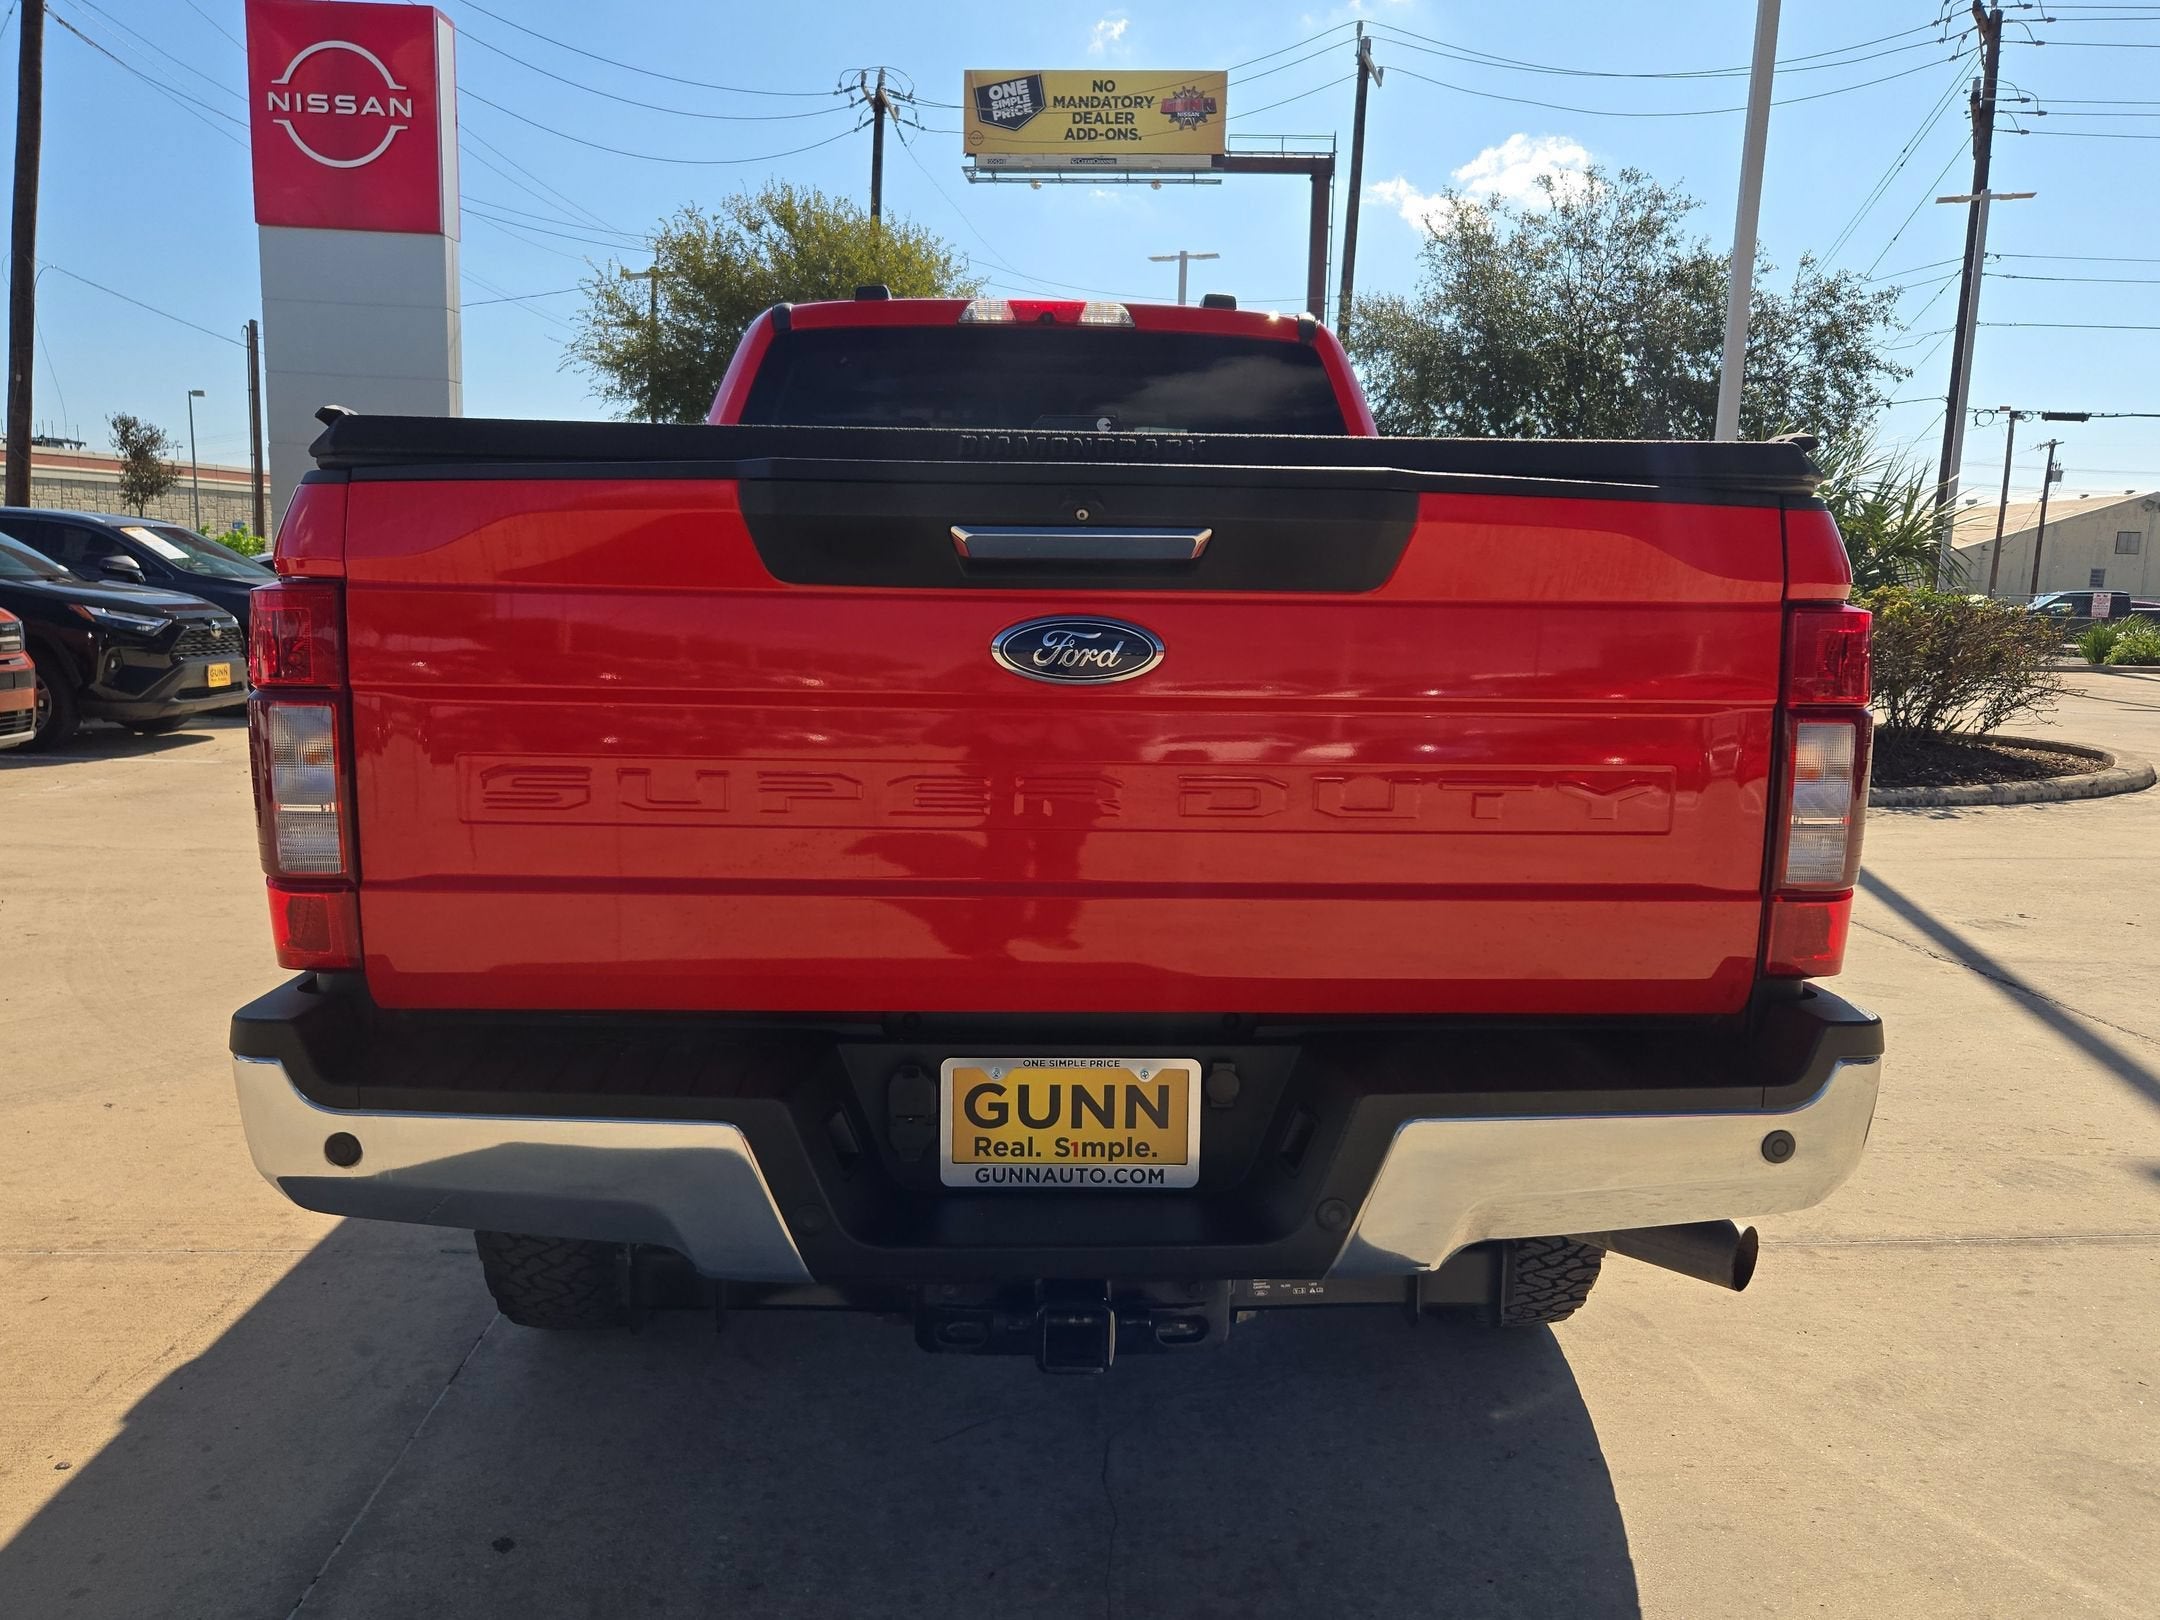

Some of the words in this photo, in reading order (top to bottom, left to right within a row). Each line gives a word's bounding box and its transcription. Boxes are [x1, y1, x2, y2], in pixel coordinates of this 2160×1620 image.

[988, 79, 1029, 100] ONE
[1091, 79, 1115, 93] NO
[267, 91, 413, 118] NISSAN
[991, 93, 1031, 110] SIMPLE
[1053, 95, 1155, 109] MANDATORY
[992, 102, 1033, 121] PRICE
[1072, 111, 1134, 125] DEALER
[1064, 127, 1142, 141] ADD-ONS.
[1032, 630, 1125, 668] Ford
[210, 667, 228, 677] GUNN
[480, 764, 1125, 817] SUPER
[1177, 774, 1654, 820] DUTY
[1022, 1059, 1046, 1067] ONE
[1048, 1059, 1087, 1067] SIMPLE
[1089, 1059, 1120, 1067] PRICE
[964, 1082, 1170, 1130] GUNN
[974, 1136, 1042, 1158] Real.
[975, 1167, 1165, 1185] GUNNAUTO.COM
